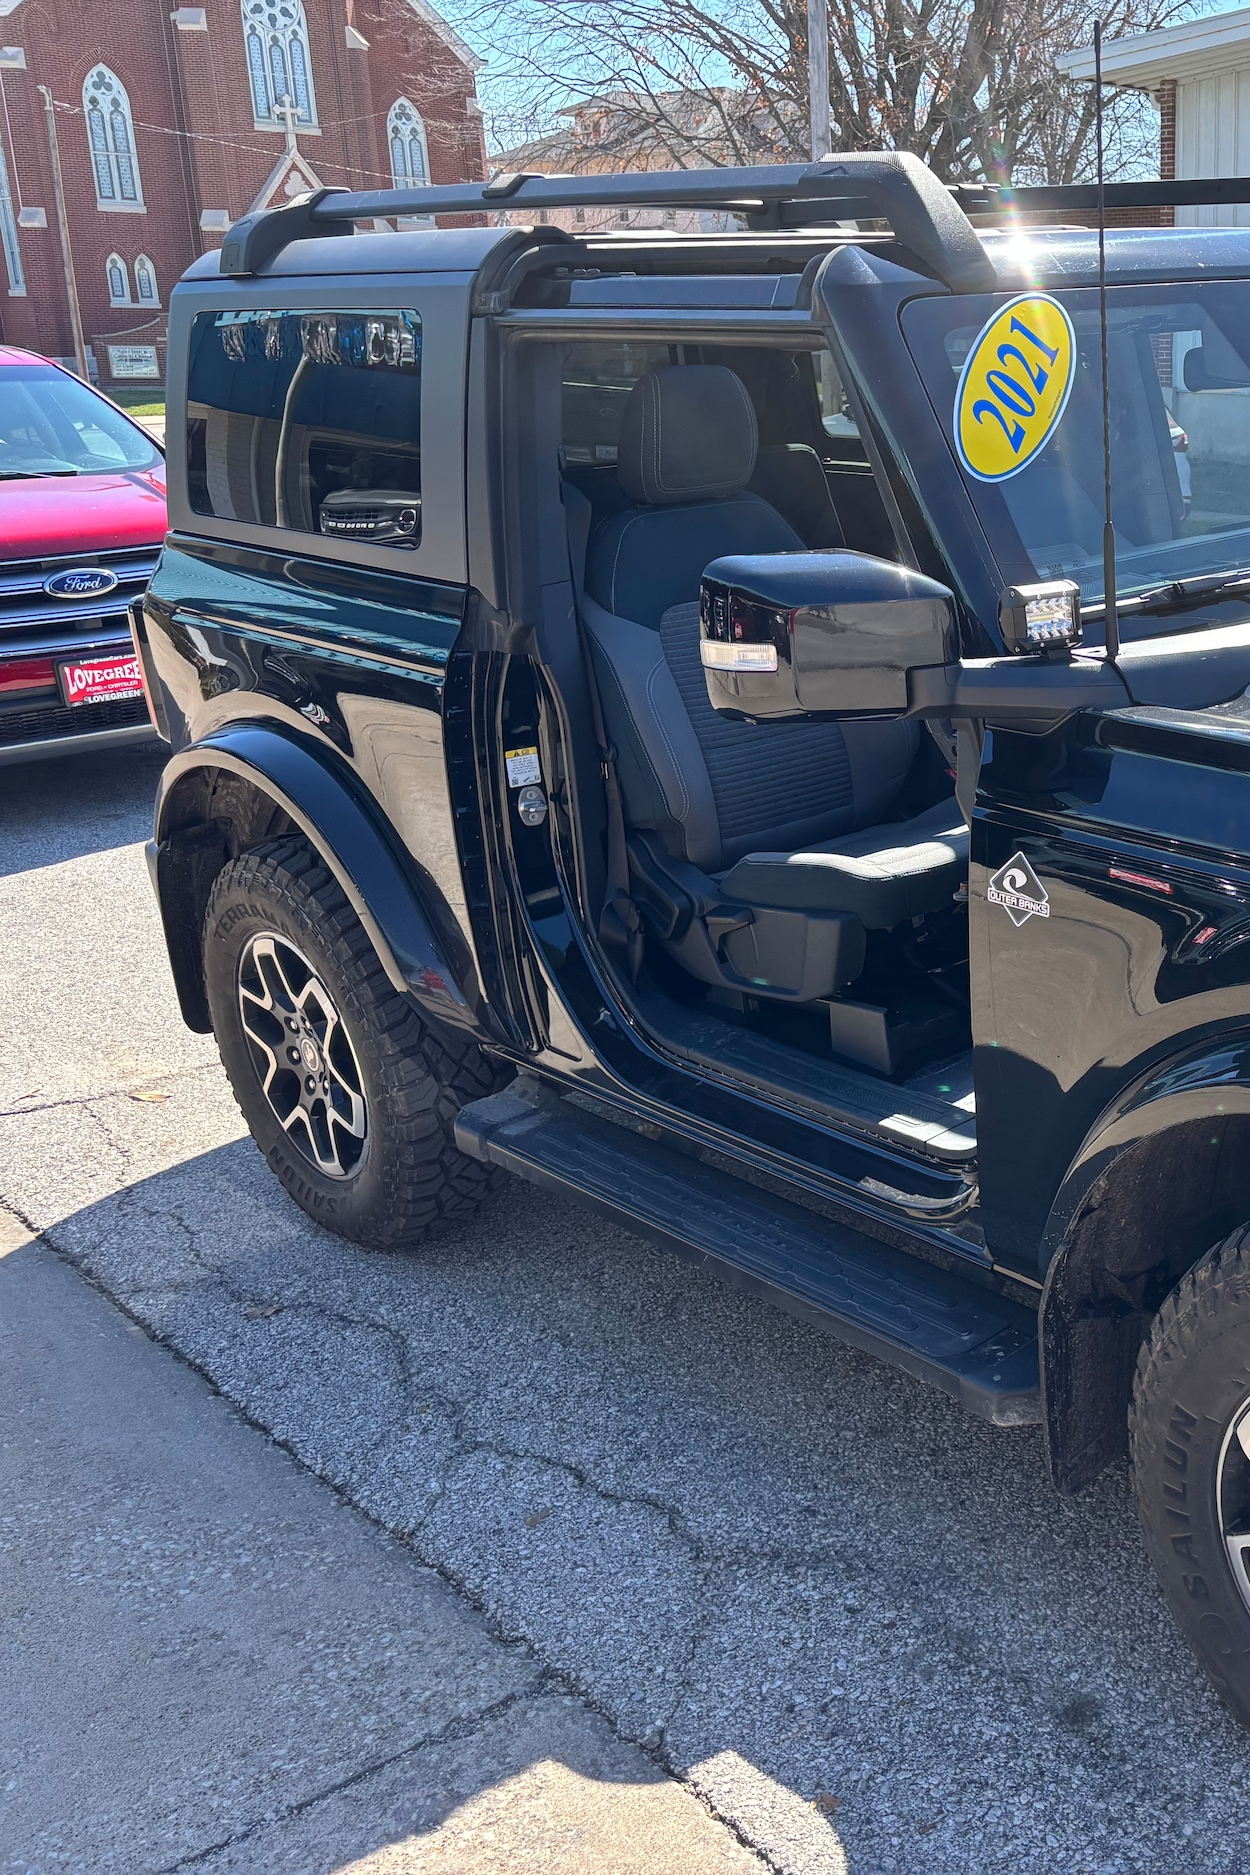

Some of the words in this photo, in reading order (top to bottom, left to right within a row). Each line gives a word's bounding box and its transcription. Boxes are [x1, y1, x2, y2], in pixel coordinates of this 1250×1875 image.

[972, 315, 1060, 454] 2021
[63, 573, 103, 592] Ford
[63, 660, 142, 696] LOVEGREE
[88, 689, 141, 703] LOVEGREEN
[990, 891, 1017, 905] OUTER
[1018, 899, 1047, 914] BANKS
[214, 903, 301, 945] TERRAMA
[268, 1145, 338, 1213] SAILUN
[1163, 1399, 1210, 1600] SAILUN
